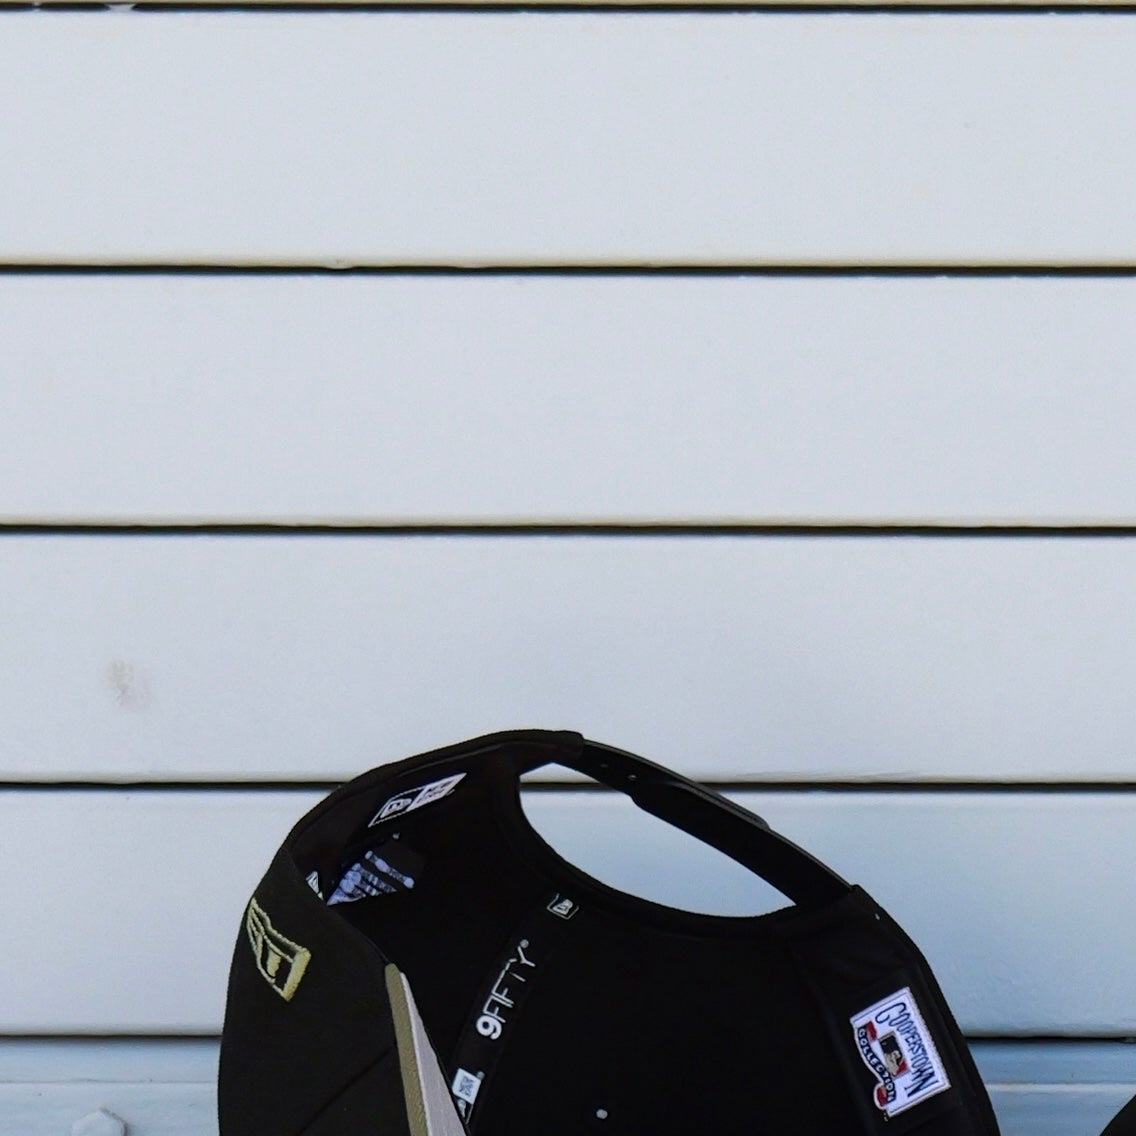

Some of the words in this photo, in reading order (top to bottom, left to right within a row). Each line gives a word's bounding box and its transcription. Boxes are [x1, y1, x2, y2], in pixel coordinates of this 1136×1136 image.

[476, 946, 535, 1040] 9FIFTY
[858, 1029, 897, 1102] COLLECTION
[875, 1002, 939, 1098] COOPERSTOWN
